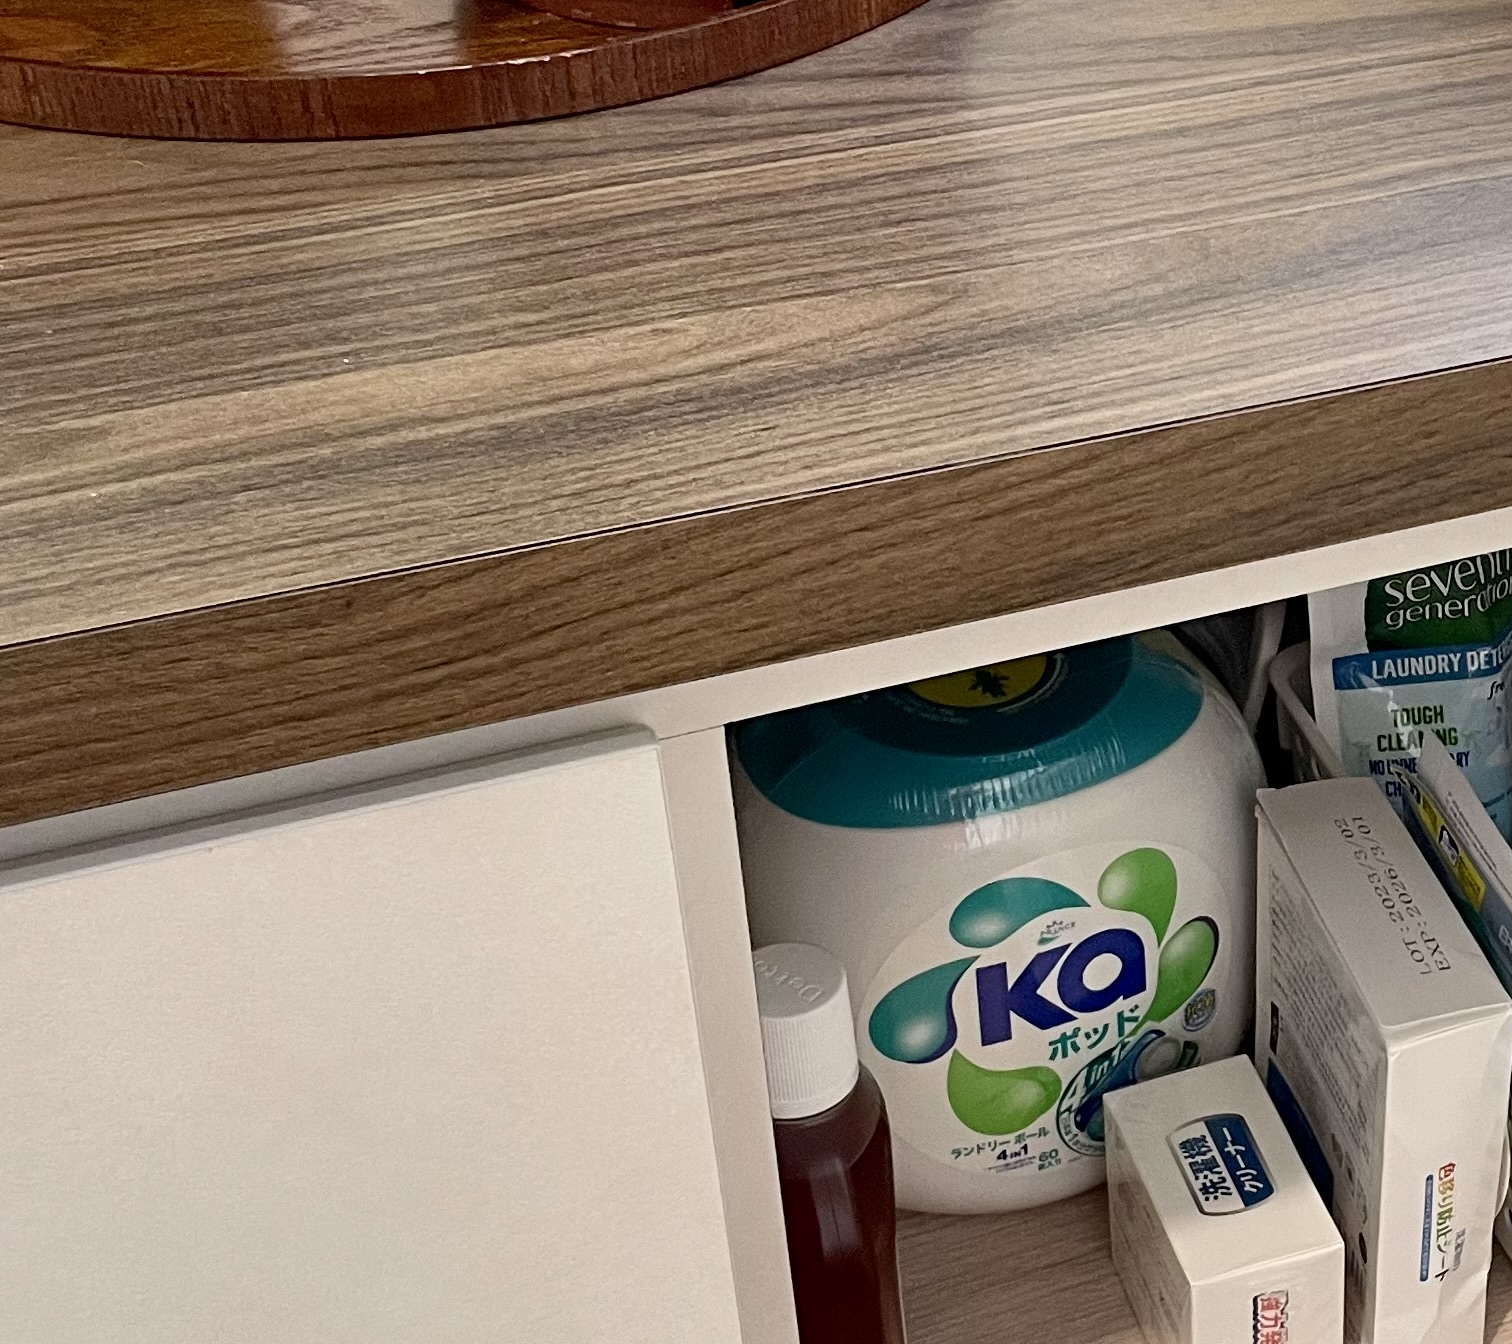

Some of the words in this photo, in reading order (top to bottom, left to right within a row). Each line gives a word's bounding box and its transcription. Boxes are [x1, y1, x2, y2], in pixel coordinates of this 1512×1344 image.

[1372, 653, 1461, 680] LAUNDRY
[1391, 705, 1445, 728] TOUGH
[1369, 759, 1385, 776] NO
[1048, 1004, 1141, 1061] ポッド
[950, 1140, 1011, 1160] ランドリー
[1038, 1148, 1059, 1162] 60
[1223, 1127, 1264, 1193] クリーナー
